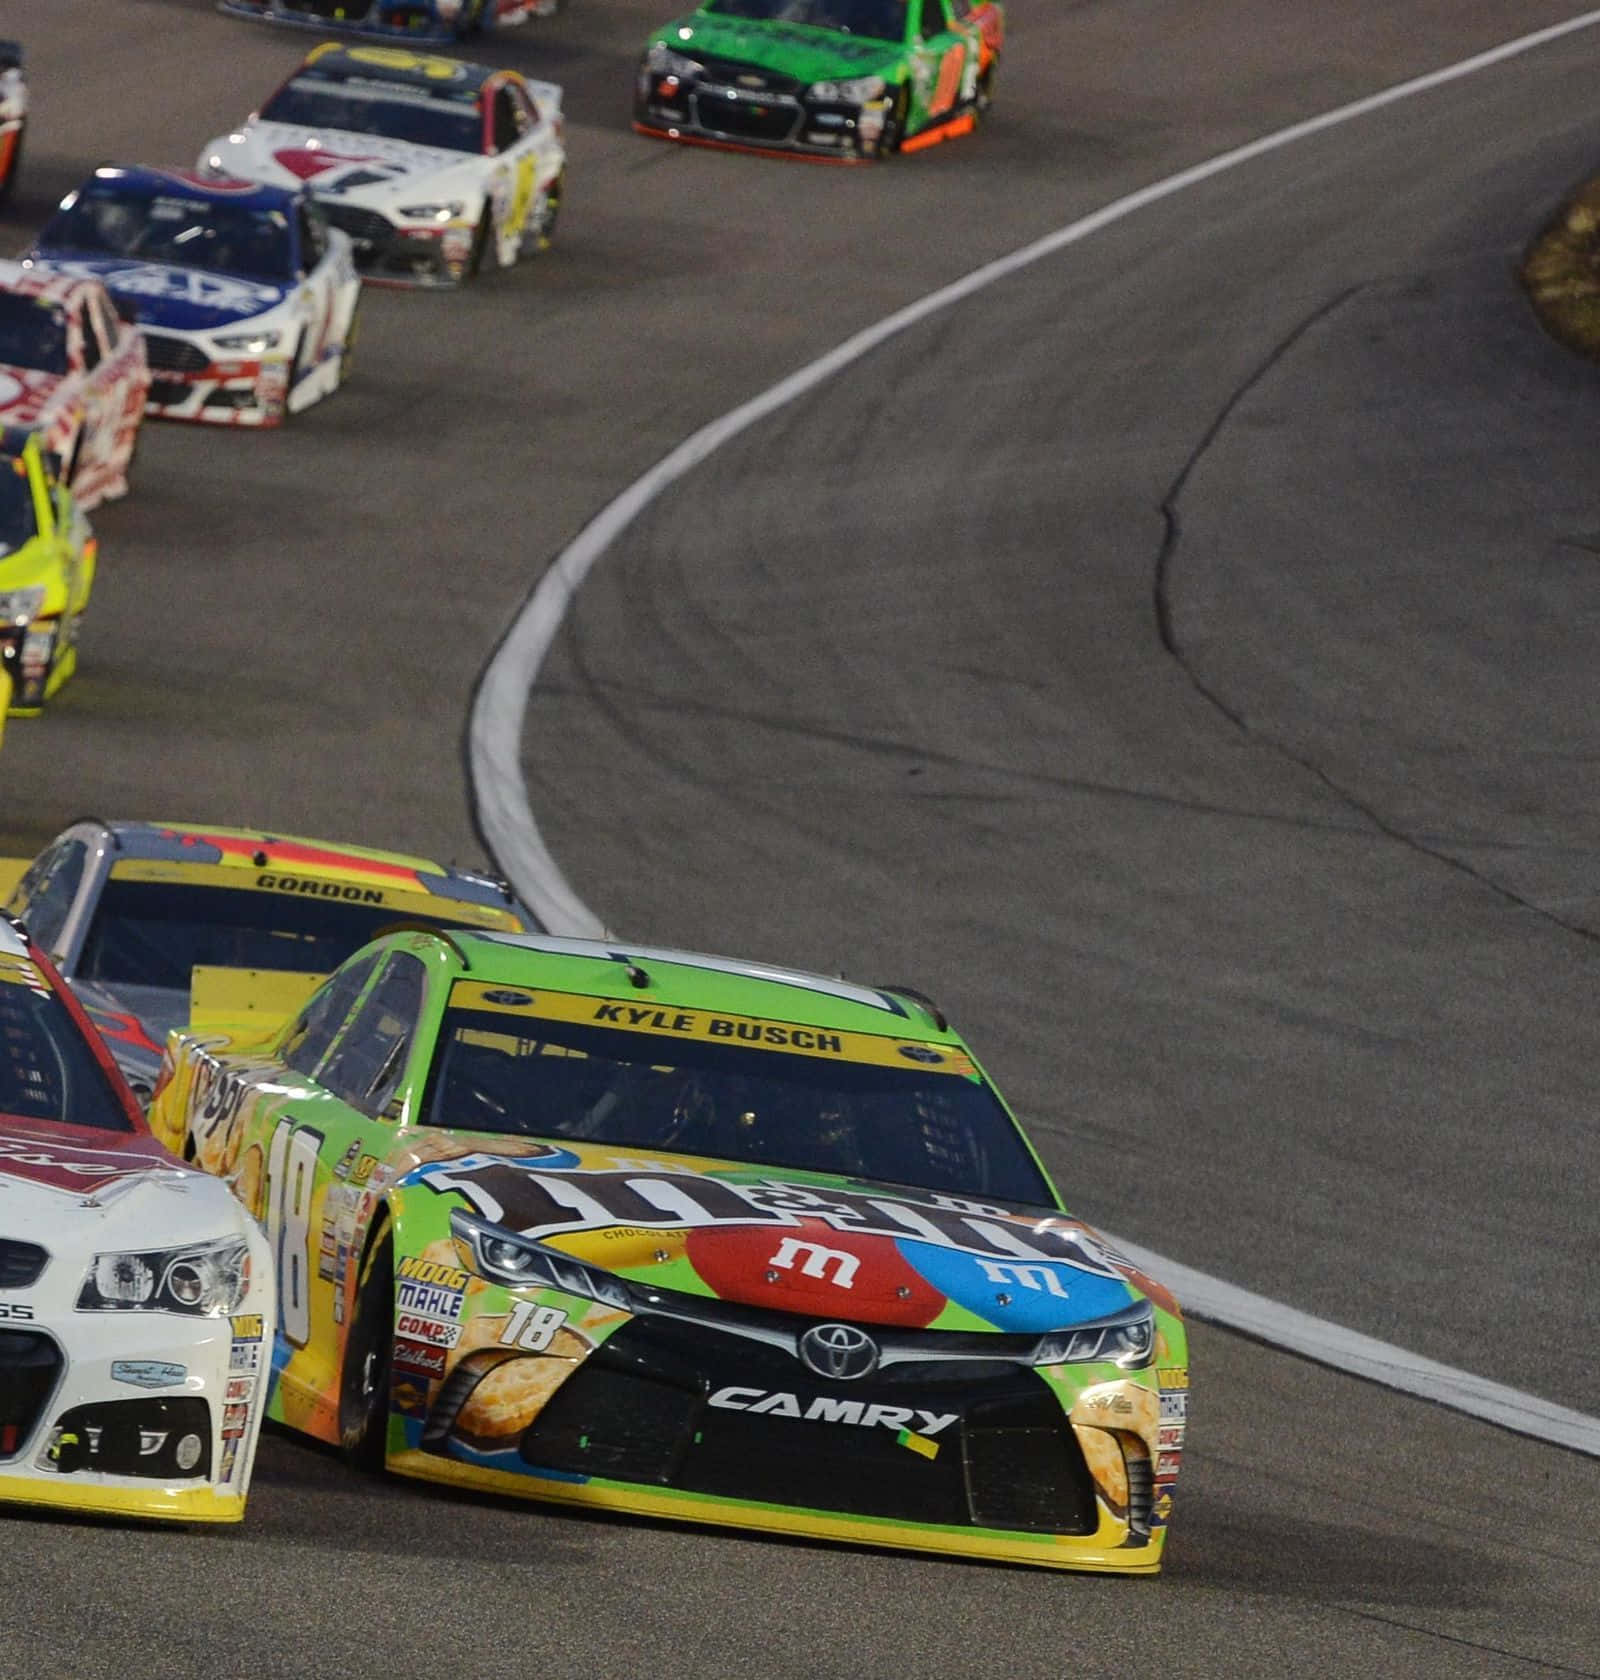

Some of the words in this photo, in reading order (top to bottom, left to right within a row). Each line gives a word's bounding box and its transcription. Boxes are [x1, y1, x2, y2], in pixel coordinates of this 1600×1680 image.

[255, 873, 384, 904] GORDON
[593, 1004, 693, 1033] KYLE
[707, 1016, 842, 1053] BUSCH
[265, 1114, 326, 1351] 18
[400, 1256, 468, 1290] MOOG
[767, 1236, 862, 1290] m
[974, 1258, 1070, 1299] m
[401, 1283, 463, 1319] MAHLE
[397, 1315, 445, 1338] COMP
[498, 1299, 568, 1353] 18
[706, 1385, 962, 1436] CAMRY
